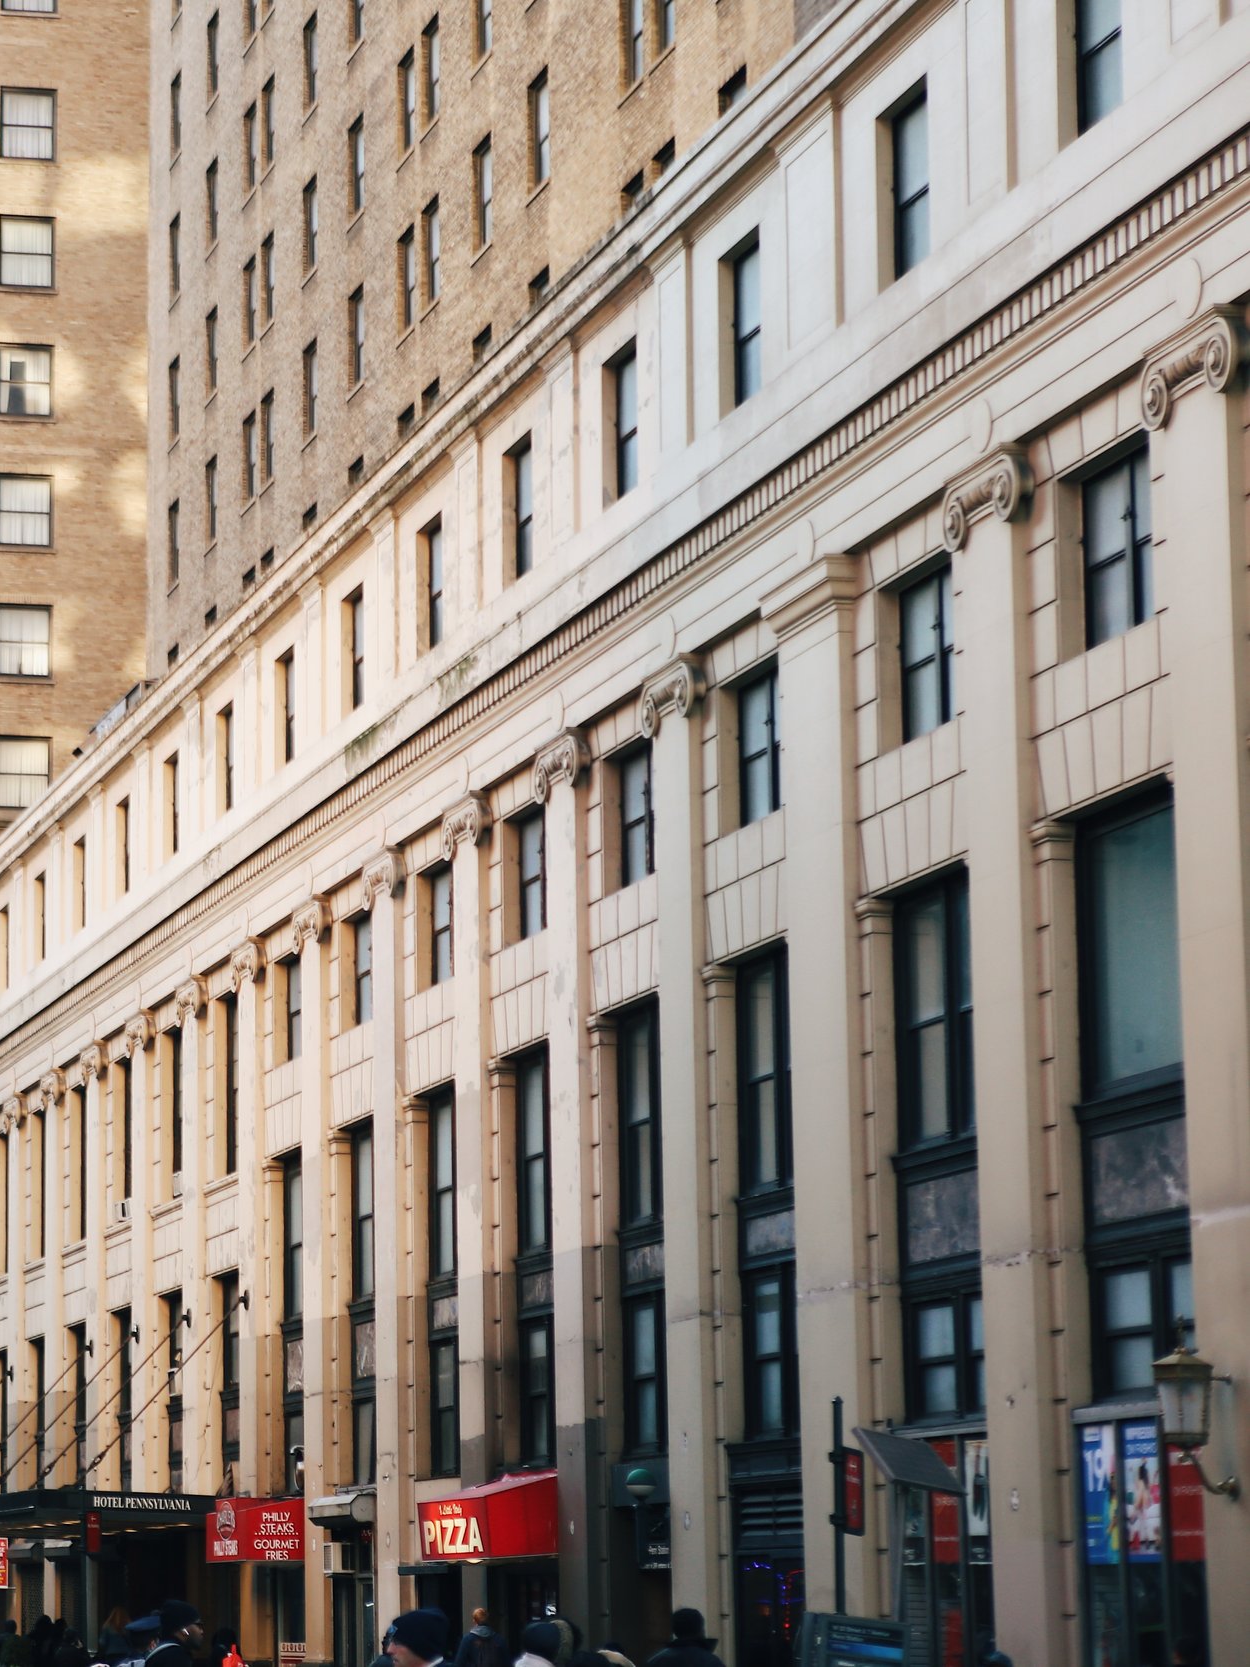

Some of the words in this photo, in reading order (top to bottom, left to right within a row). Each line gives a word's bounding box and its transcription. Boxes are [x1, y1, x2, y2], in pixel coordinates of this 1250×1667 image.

[93, 1495, 124, 1508] HOTEL
[125, 1496, 191, 1511] PENNSYLVANIA
[262, 1511, 290, 1522] PHILLY
[260, 1522, 295, 1533] STEAKS
[423, 1516, 484, 1555] PIZZA
[254, 1539, 300, 1550] GOURMET
[265, 1550, 289, 1560] FRIES
